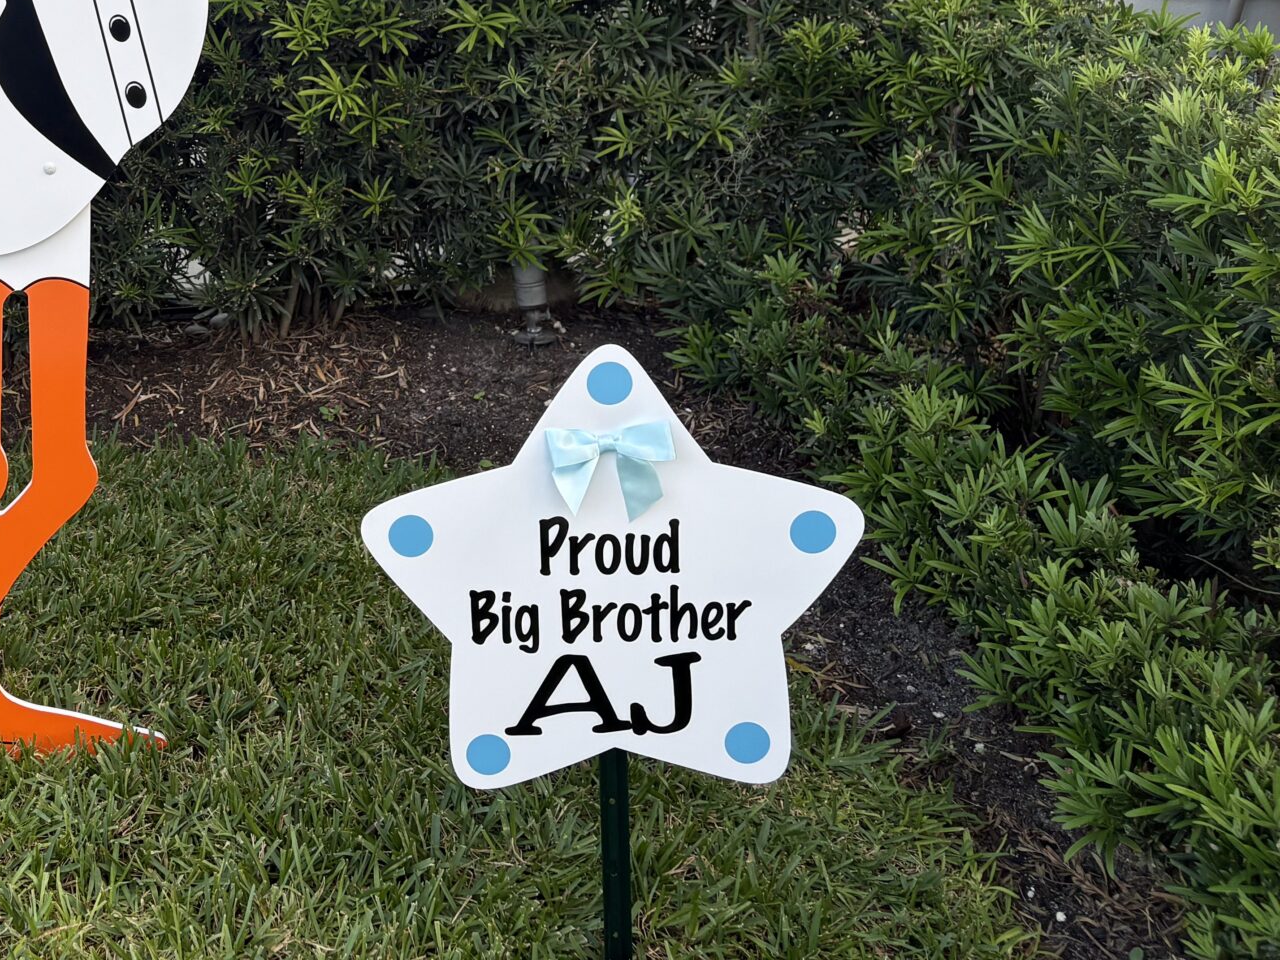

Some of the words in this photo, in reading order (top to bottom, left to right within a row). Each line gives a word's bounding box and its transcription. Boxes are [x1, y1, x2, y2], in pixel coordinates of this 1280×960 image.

[538, 515, 680, 576] Proud
[469, 588, 539, 653] Big
[559, 584, 752, 644] Brother
[504, 651, 702, 737] AJ
